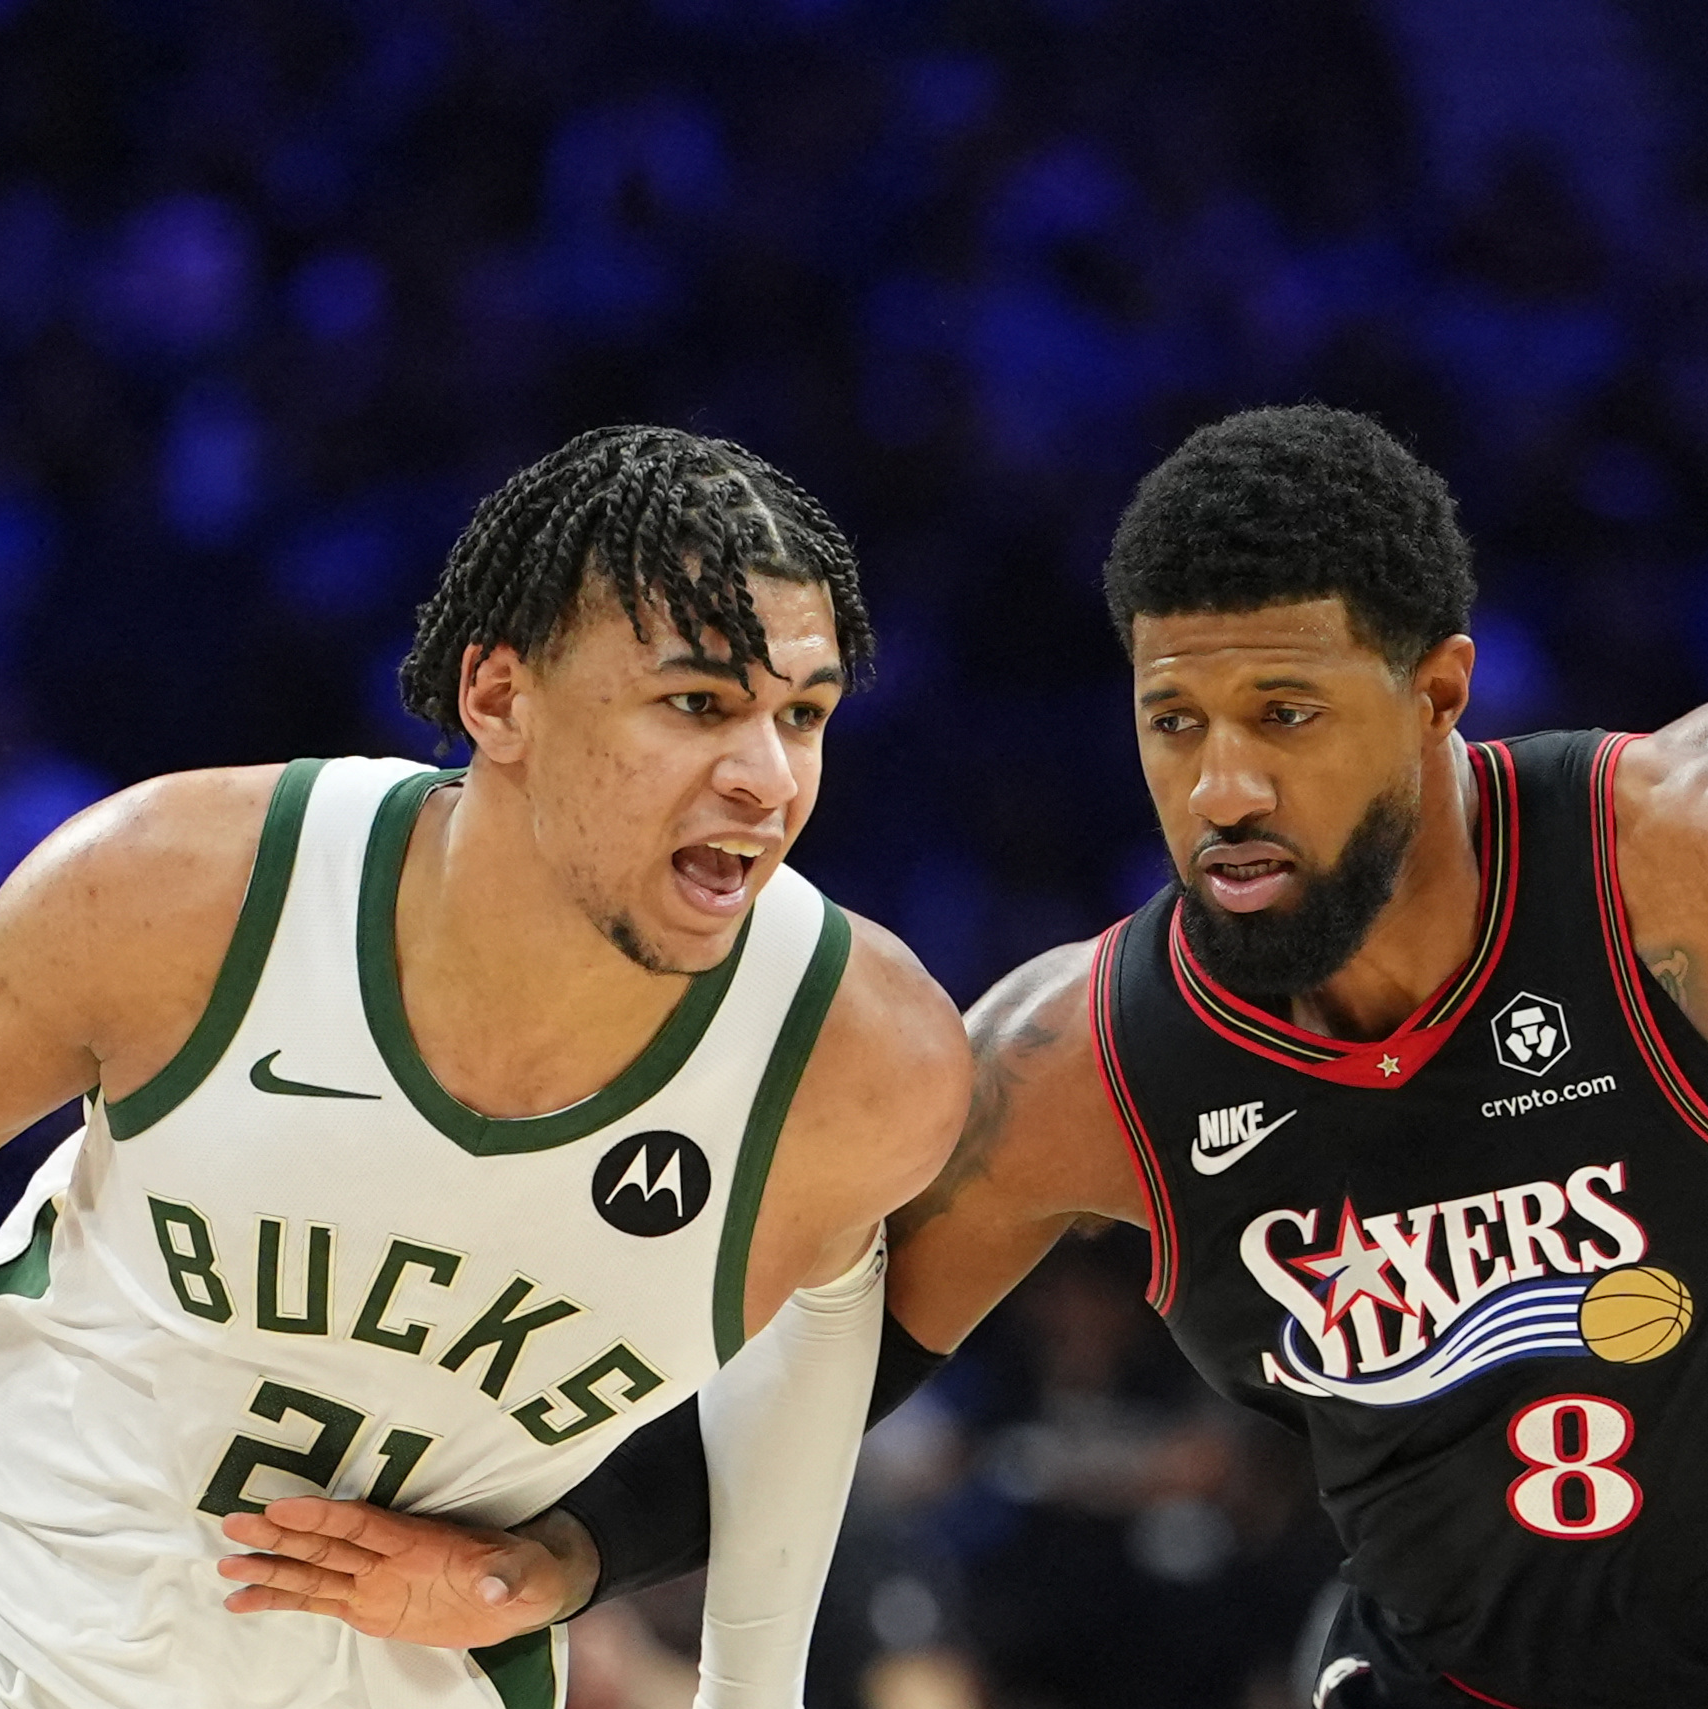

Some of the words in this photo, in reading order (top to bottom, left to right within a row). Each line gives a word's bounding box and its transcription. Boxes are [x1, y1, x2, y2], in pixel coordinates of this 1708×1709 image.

[1198, 1101, 1264, 1150] NIKE
[1481, 1072, 1616, 1119] crypto.com
[146, 1190, 667, 1448] BUCKS
[196, 1375, 442, 1524] 21
[1507, 1392, 1643, 1540] 8
